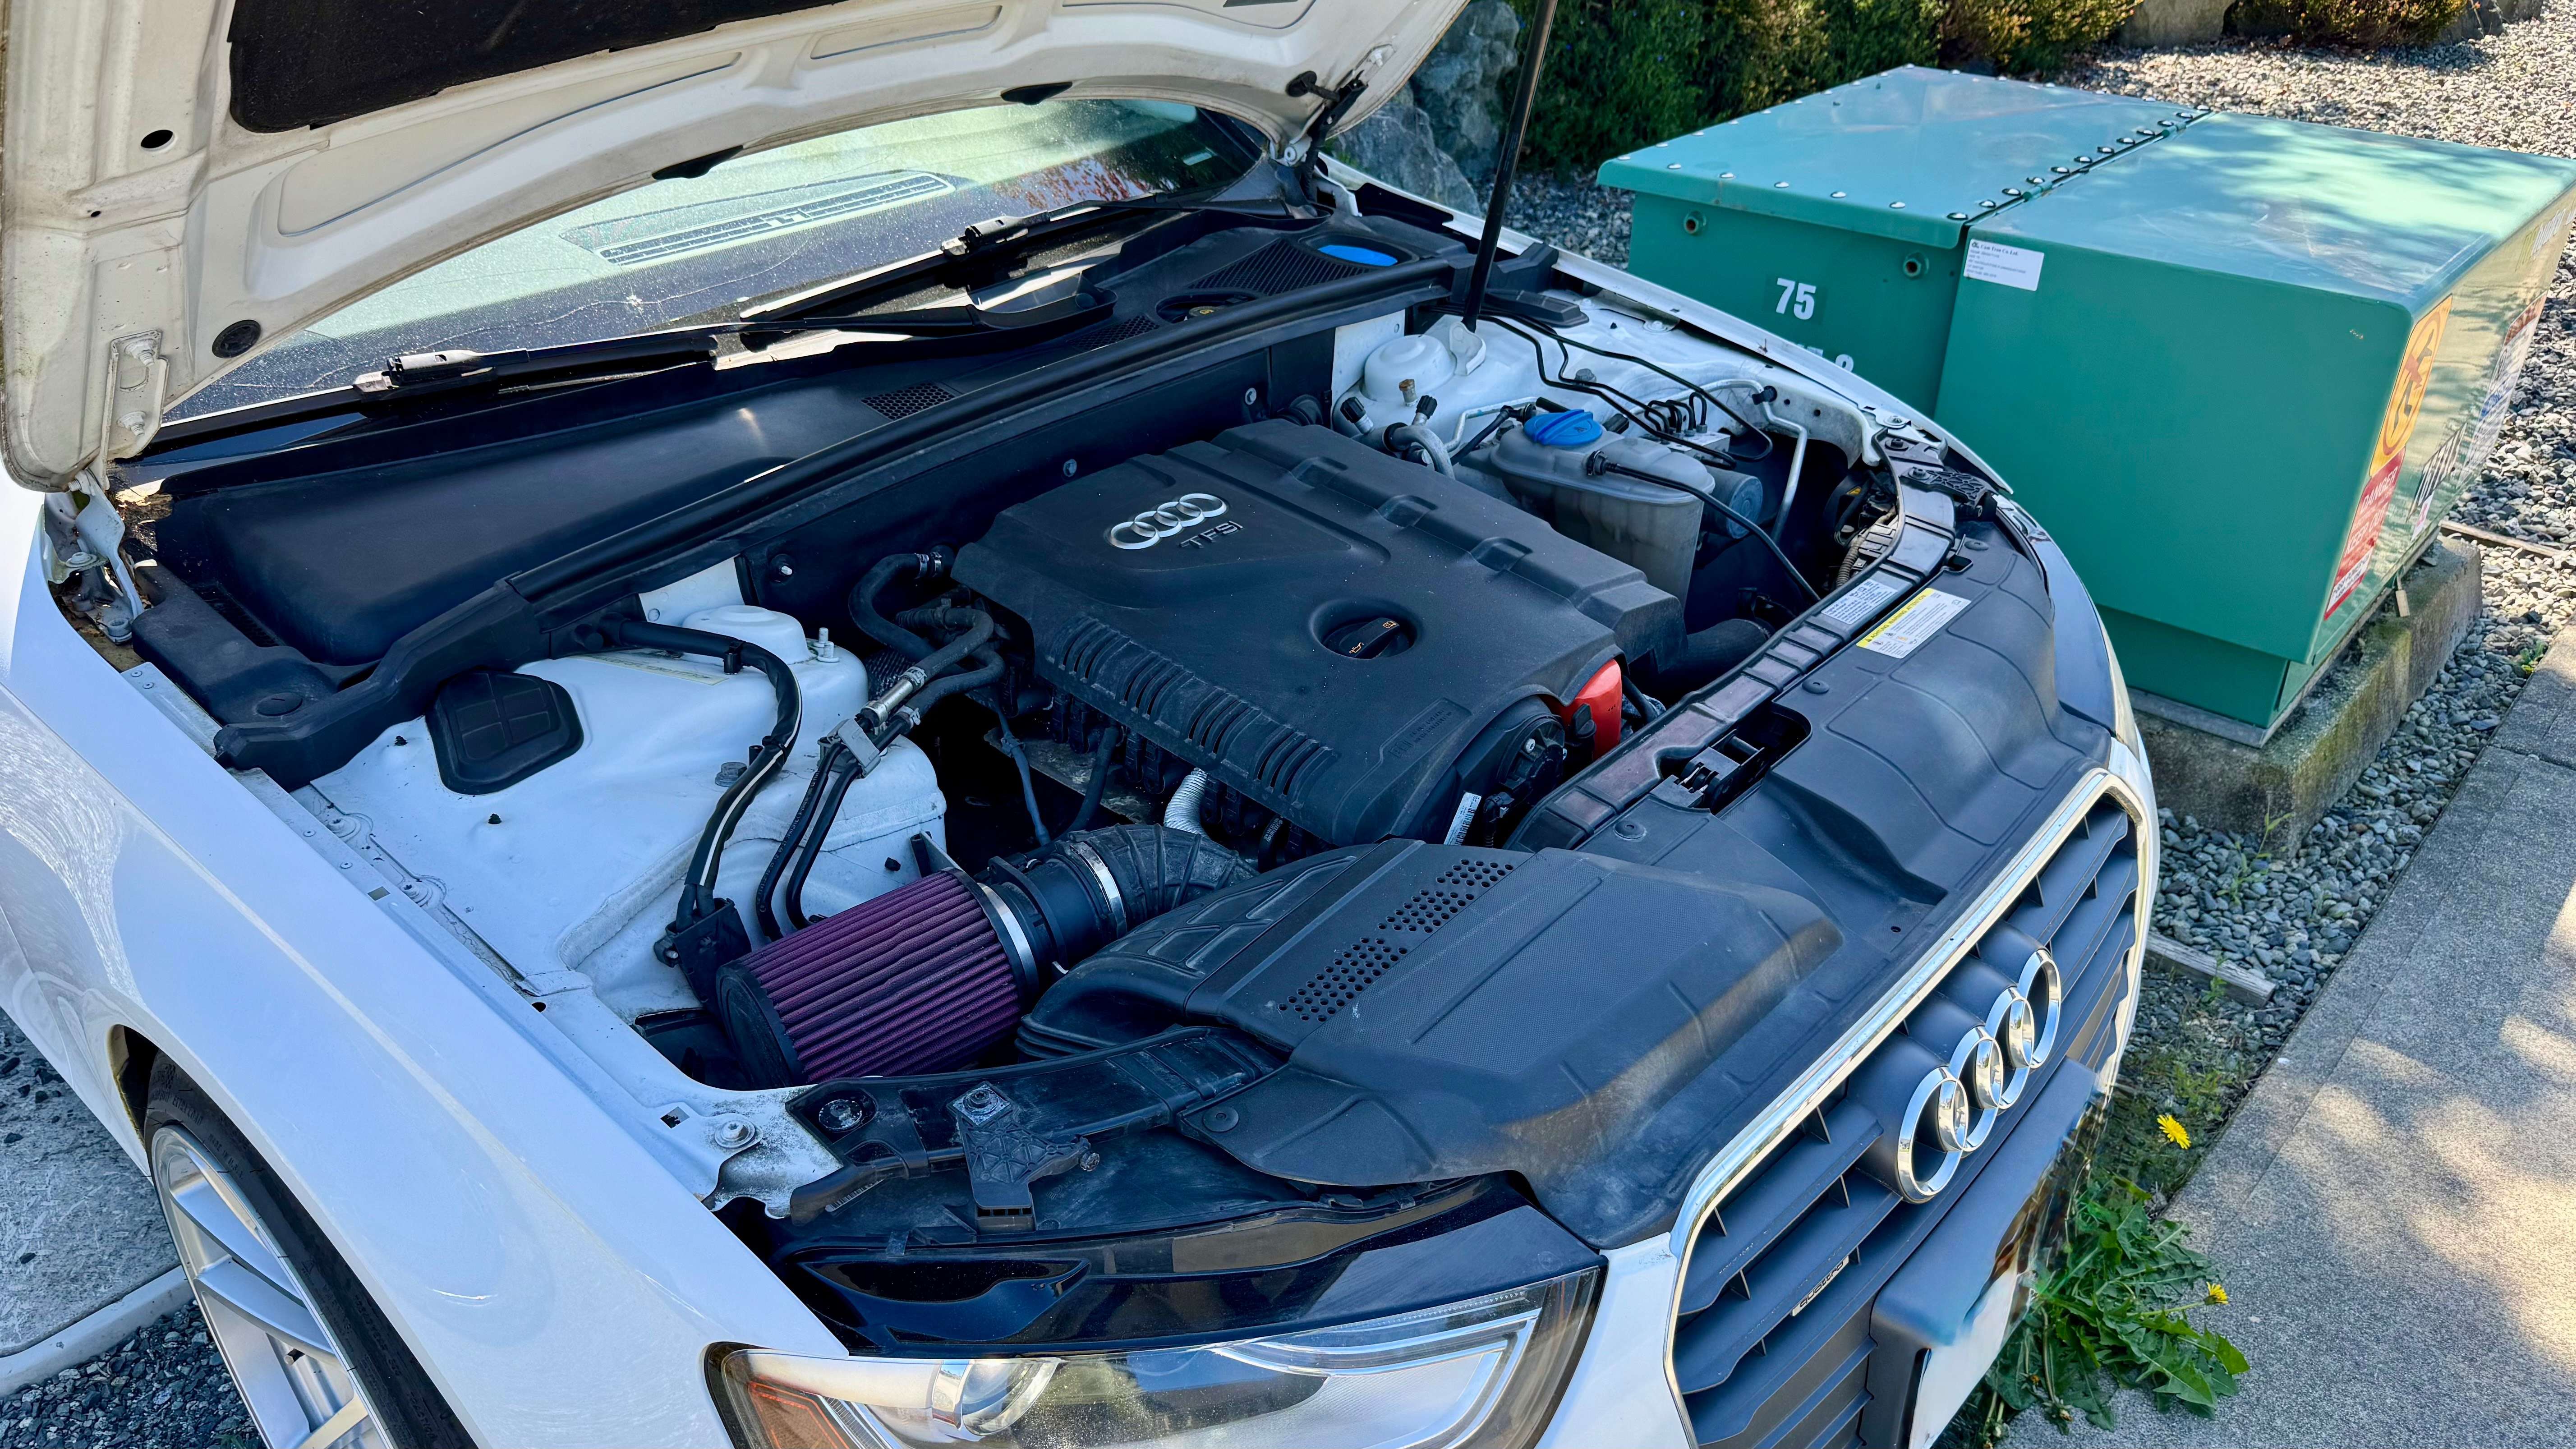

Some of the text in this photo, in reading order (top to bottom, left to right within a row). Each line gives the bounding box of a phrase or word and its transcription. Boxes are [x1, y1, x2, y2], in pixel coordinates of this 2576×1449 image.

[1776, 278, 1817, 320] 75
[2361, 466, 2398, 513] DANGER
[1178, 520, 1243, 548] TFSI
[1871, 623, 1890, 639] ACHTUNG
[1889, 610, 1907, 624] WARNING
[1906, 595, 1926, 611] ATTENTION
[1799, 1260, 1844, 1308] quattro
